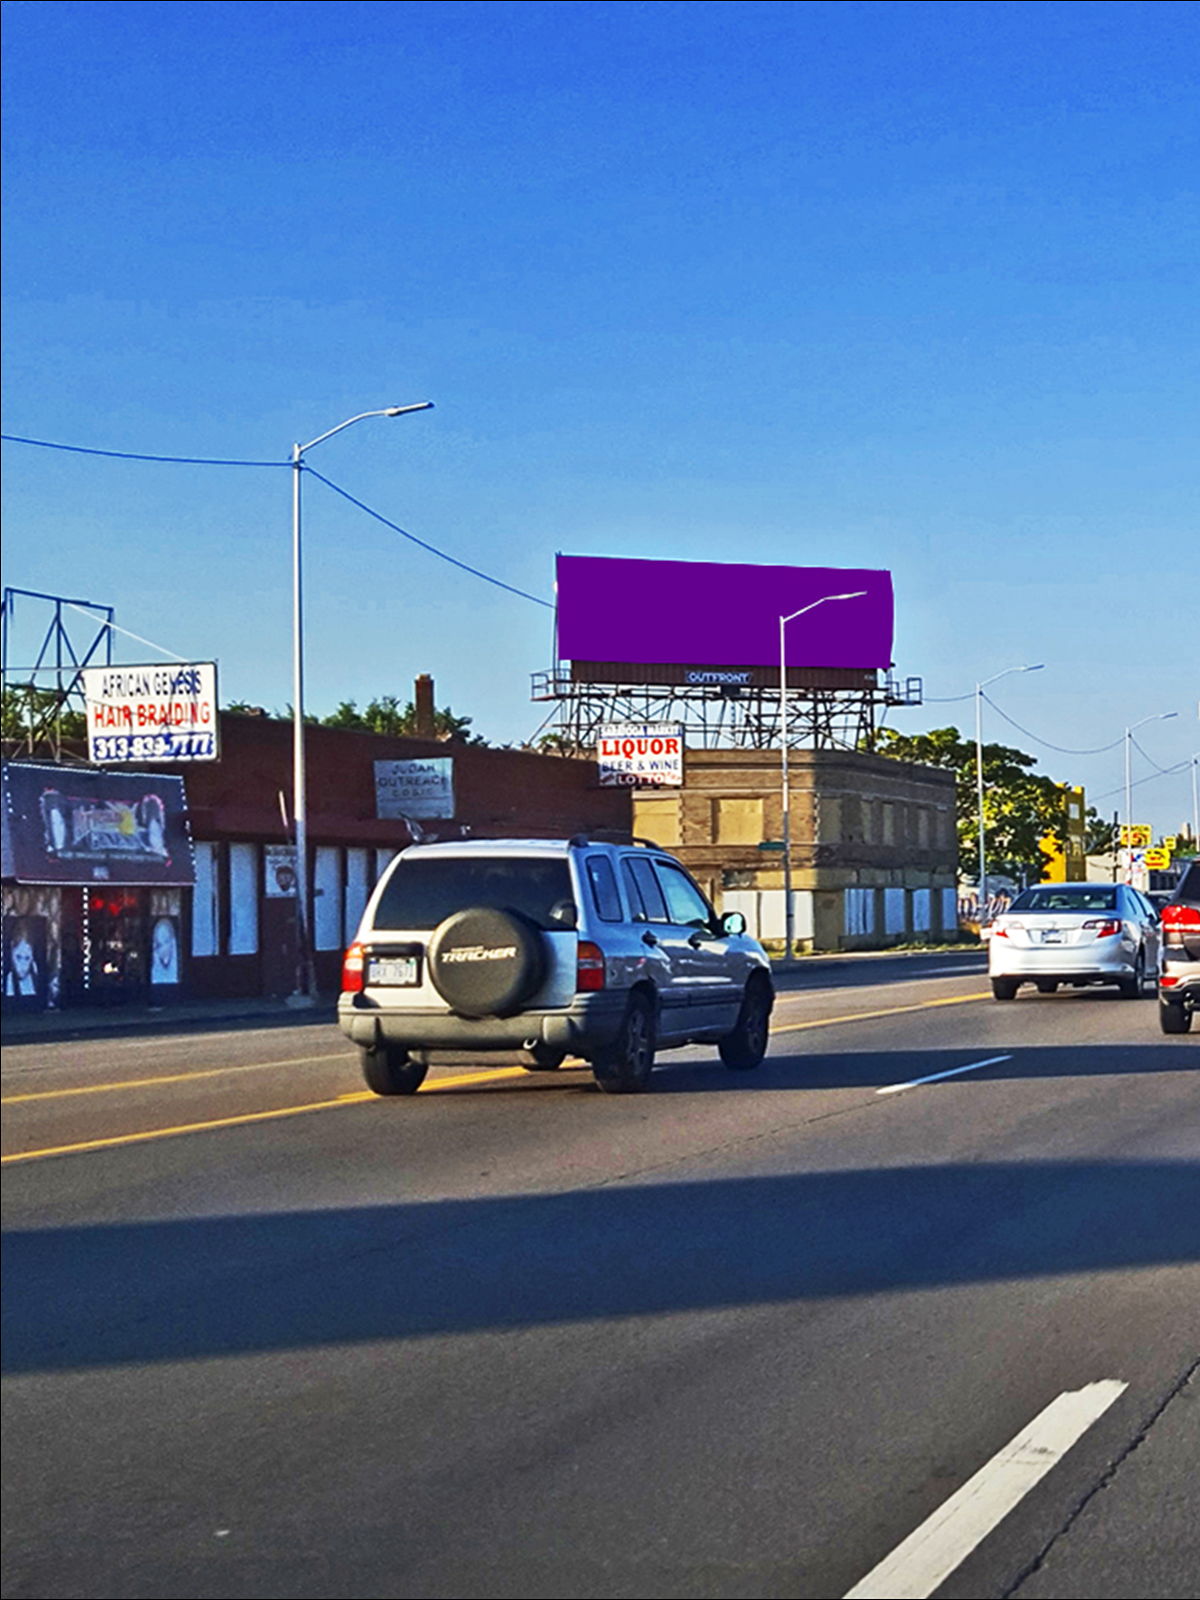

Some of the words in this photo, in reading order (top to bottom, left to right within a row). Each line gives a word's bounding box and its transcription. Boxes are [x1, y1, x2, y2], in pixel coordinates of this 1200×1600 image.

[102, 673, 151, 698] AFRICAN
[688, 671, 750, 684] OUTFRONT
[93, 703, 133, 728] HAIR
[136, 701, 211, 727] BRAIDING
[602, 738, 679, 760] LIQUOR
[602, 760, 633, 772] BEER
[637, 760, 645, 771] &
[649, 759, 679, 770] WINE
[618, 774, 664, 785] LOTTO
[441, 947, 516, 963] TRACKER
